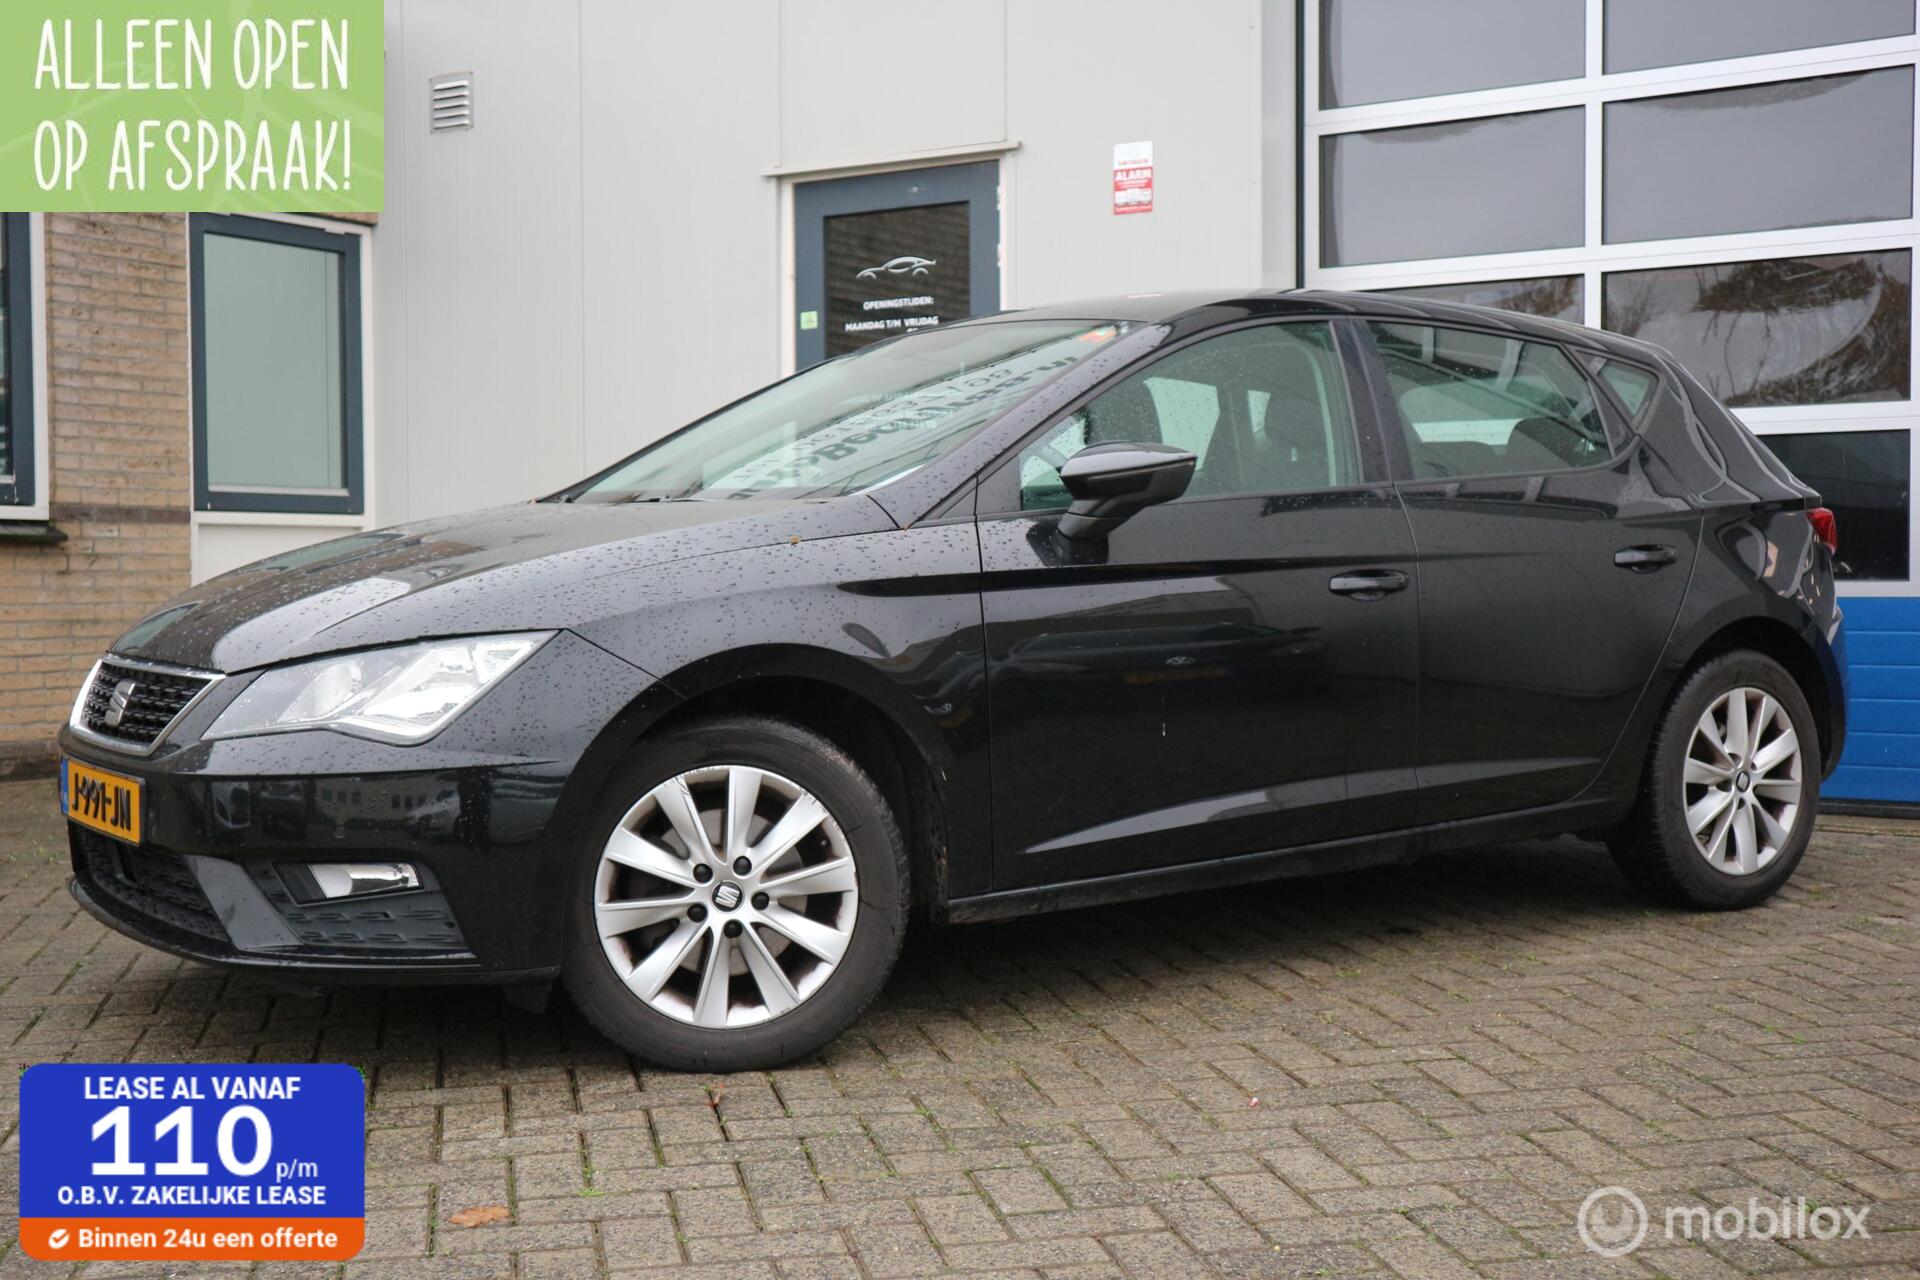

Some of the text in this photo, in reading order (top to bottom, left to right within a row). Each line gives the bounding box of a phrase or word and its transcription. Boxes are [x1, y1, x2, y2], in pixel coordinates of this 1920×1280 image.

[844, 316, 939, 332] MAANDAG T/M VRIJDAG
